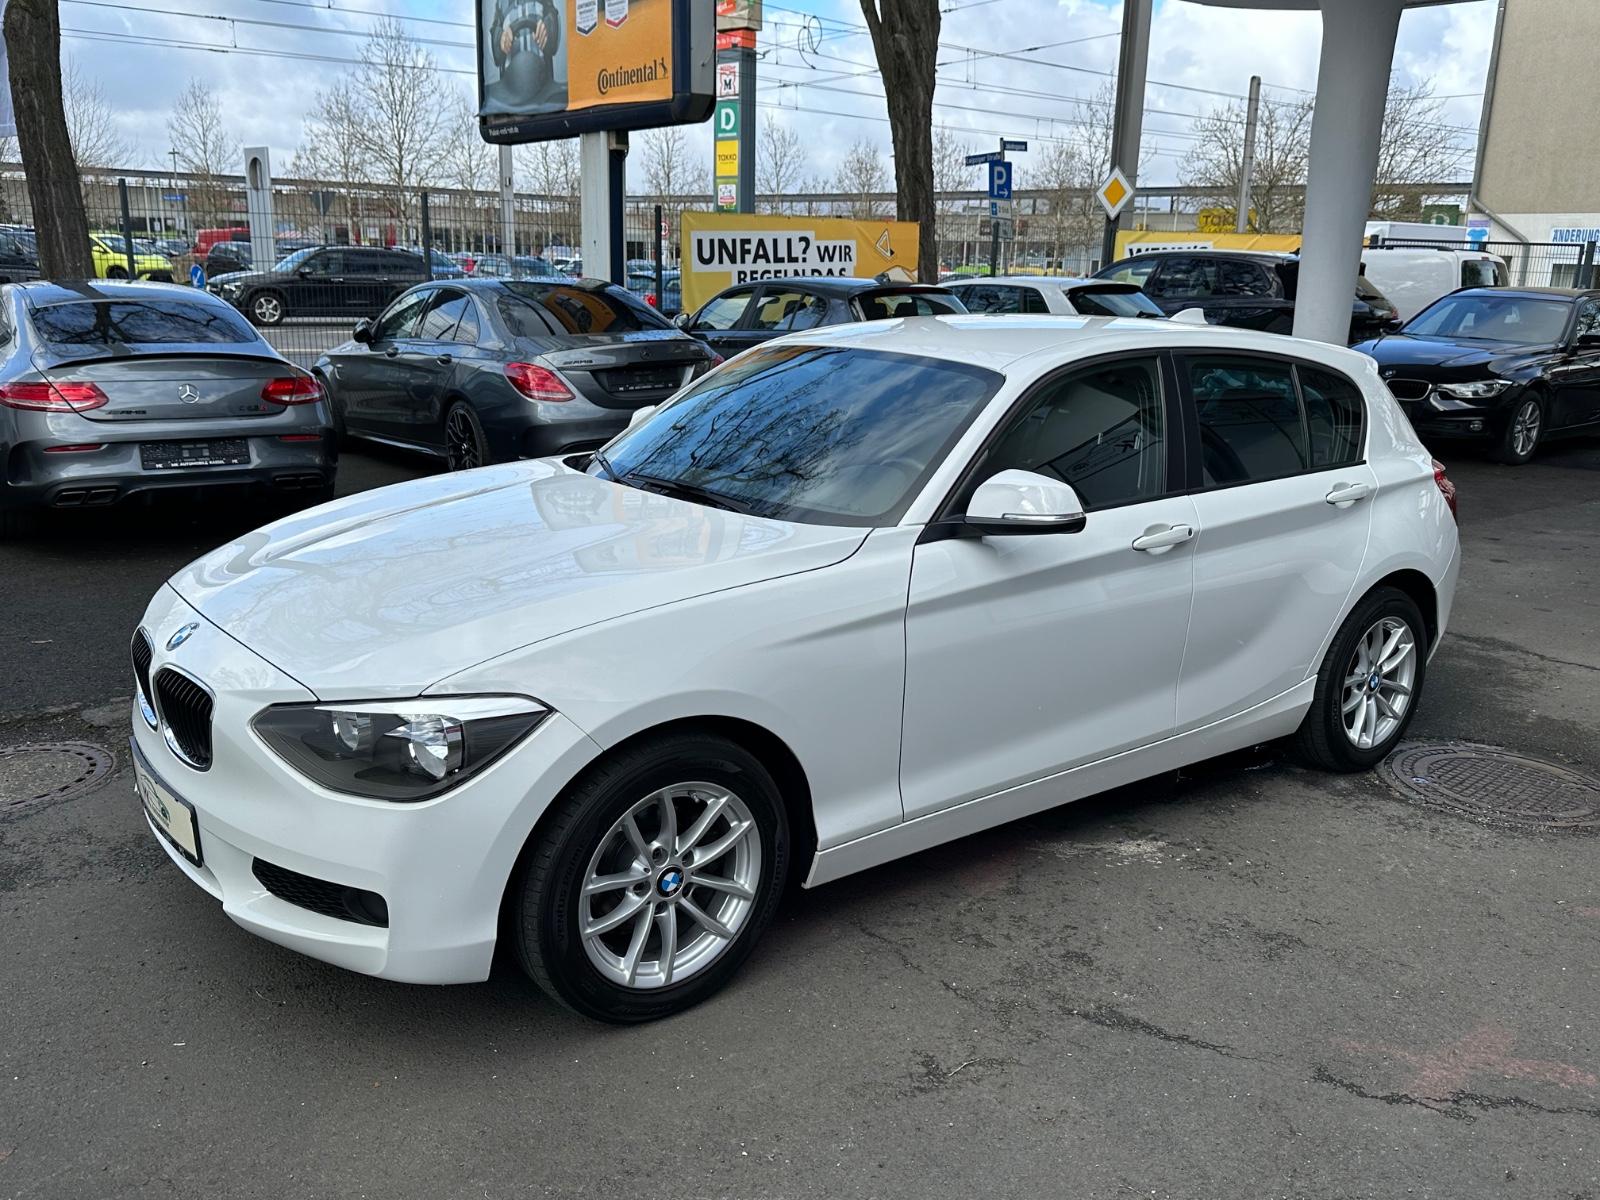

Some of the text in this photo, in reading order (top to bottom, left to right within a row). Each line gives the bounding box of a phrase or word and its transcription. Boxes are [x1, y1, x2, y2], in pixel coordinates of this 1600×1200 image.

[598, 59, 657, 95] Continental
[720, 107, 736, 131] D
[994, 166, 1007, 196] P
[697, 236, 853, 266] UNFALL? WIR
